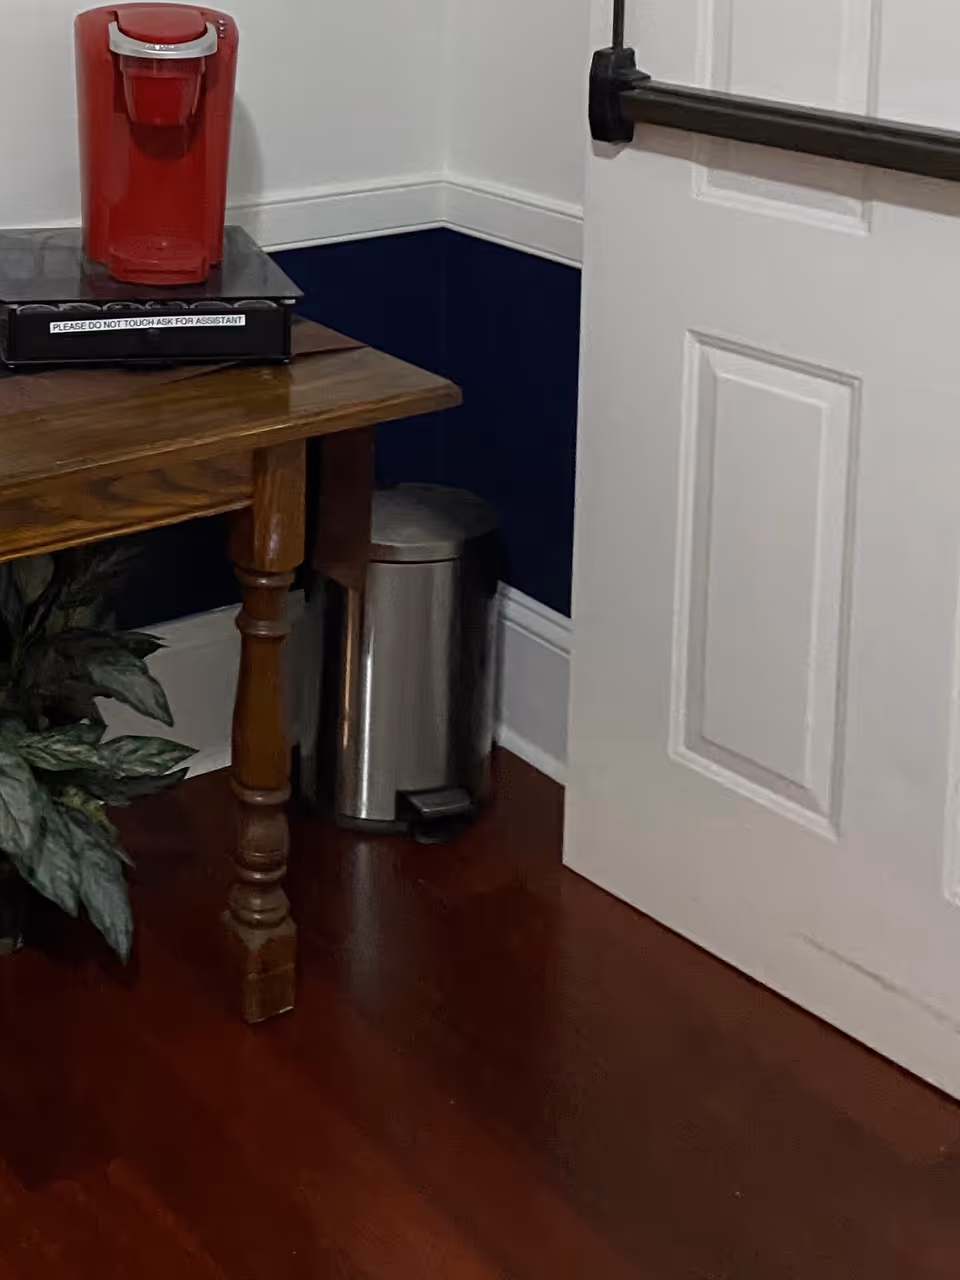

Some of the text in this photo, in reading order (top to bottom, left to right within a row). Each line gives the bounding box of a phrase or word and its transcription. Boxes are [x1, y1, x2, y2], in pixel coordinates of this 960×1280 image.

[53, 316, 243, 331] PLEASE DO NOT TOUCH ASK FOR ASSISTANT
